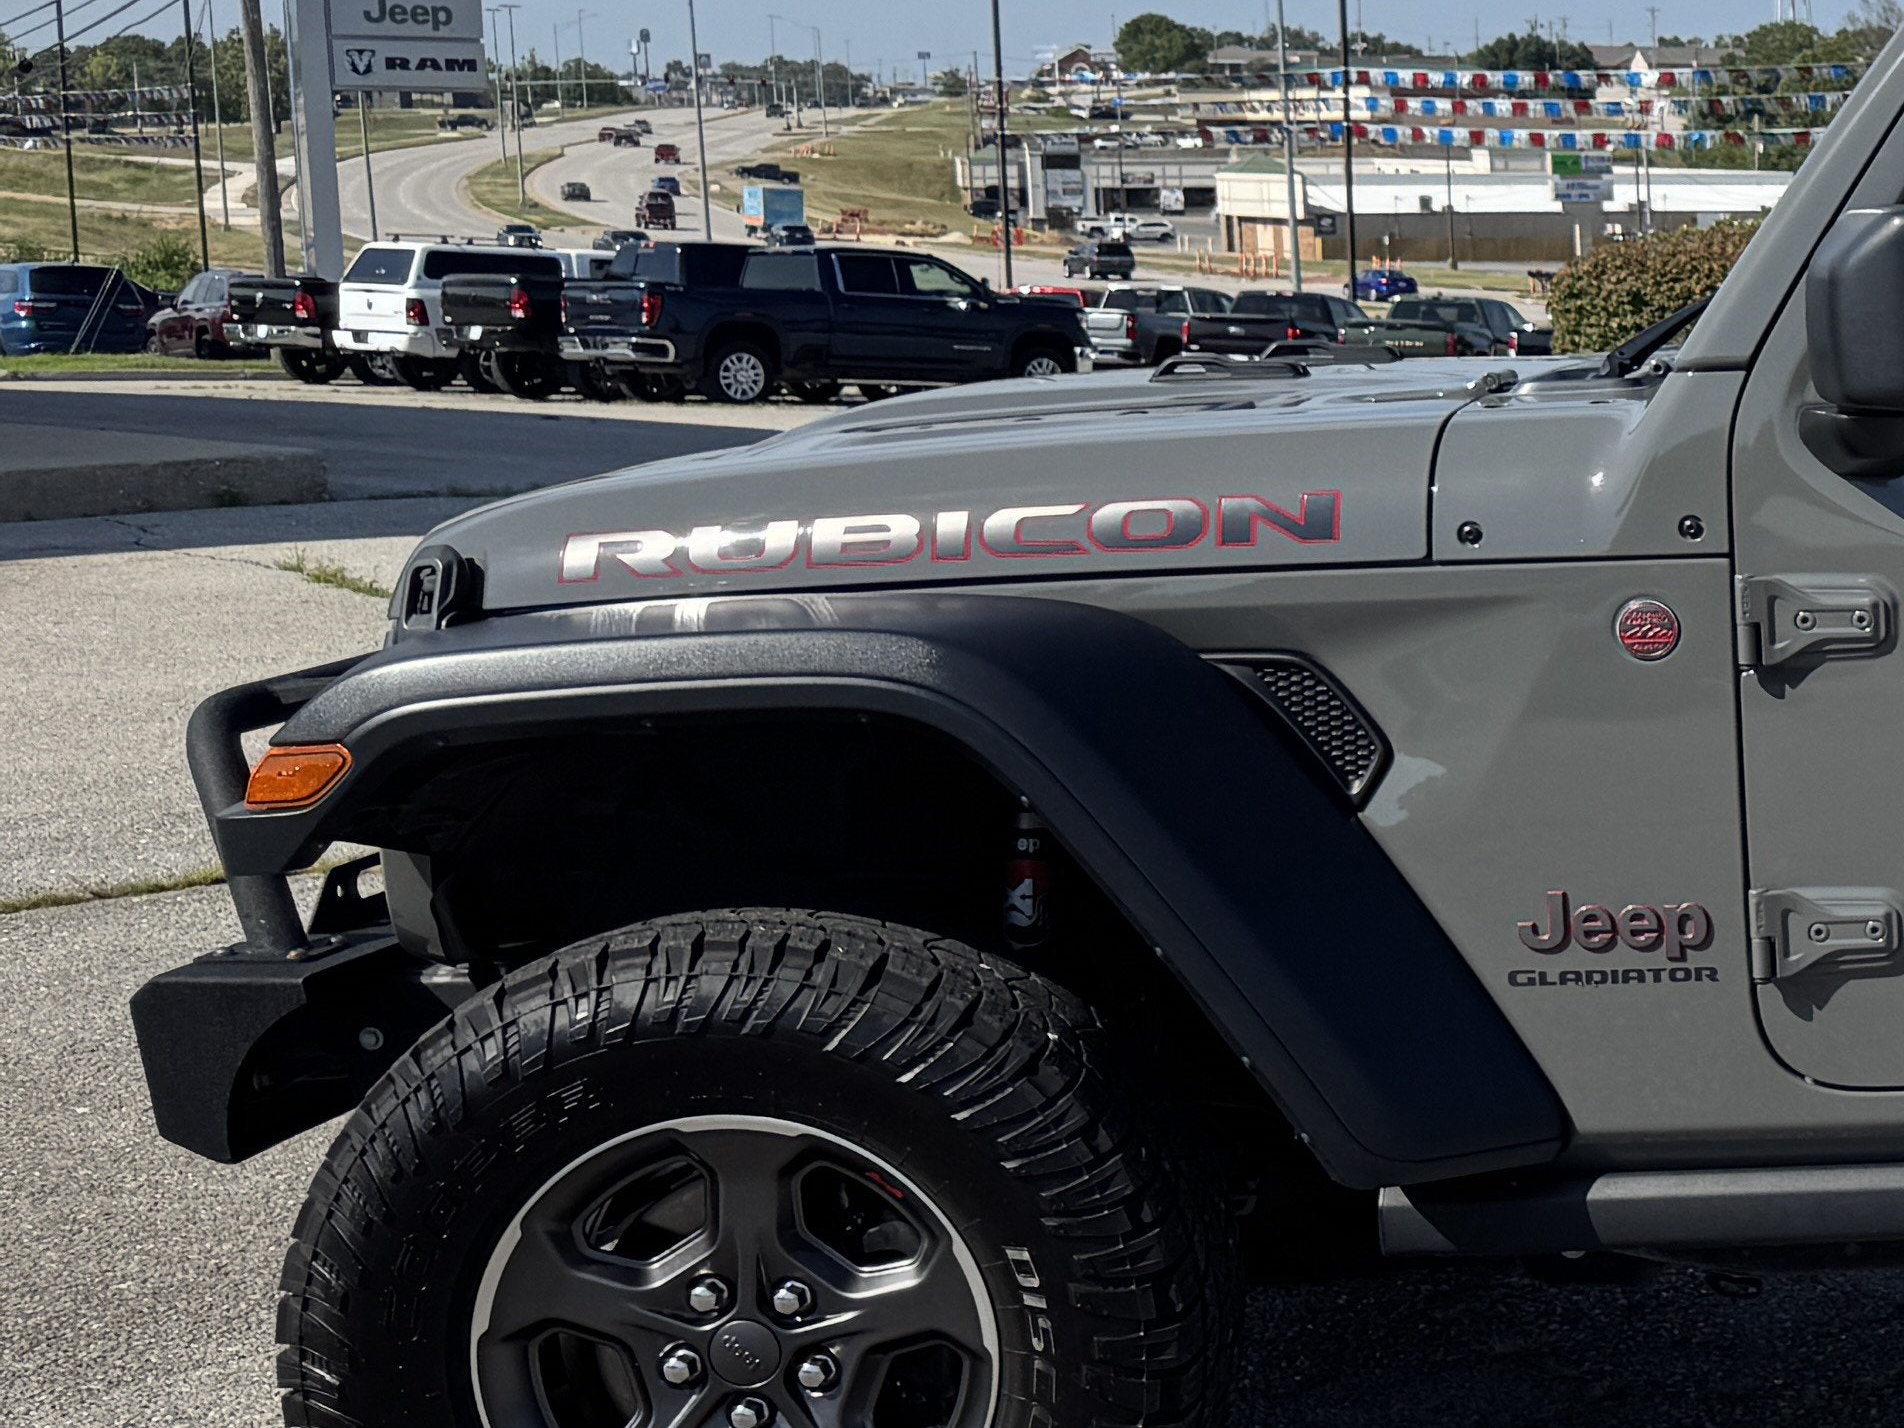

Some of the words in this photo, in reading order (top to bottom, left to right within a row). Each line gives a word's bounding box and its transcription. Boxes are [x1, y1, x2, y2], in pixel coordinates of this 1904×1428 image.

[385, 55, 478, 73] RAM
[557, 488, 1343, 585] RUBICON
[1516, 889, 1712, 962] Jeep
[1507, 966, 1720, 988] GLADIATOR
